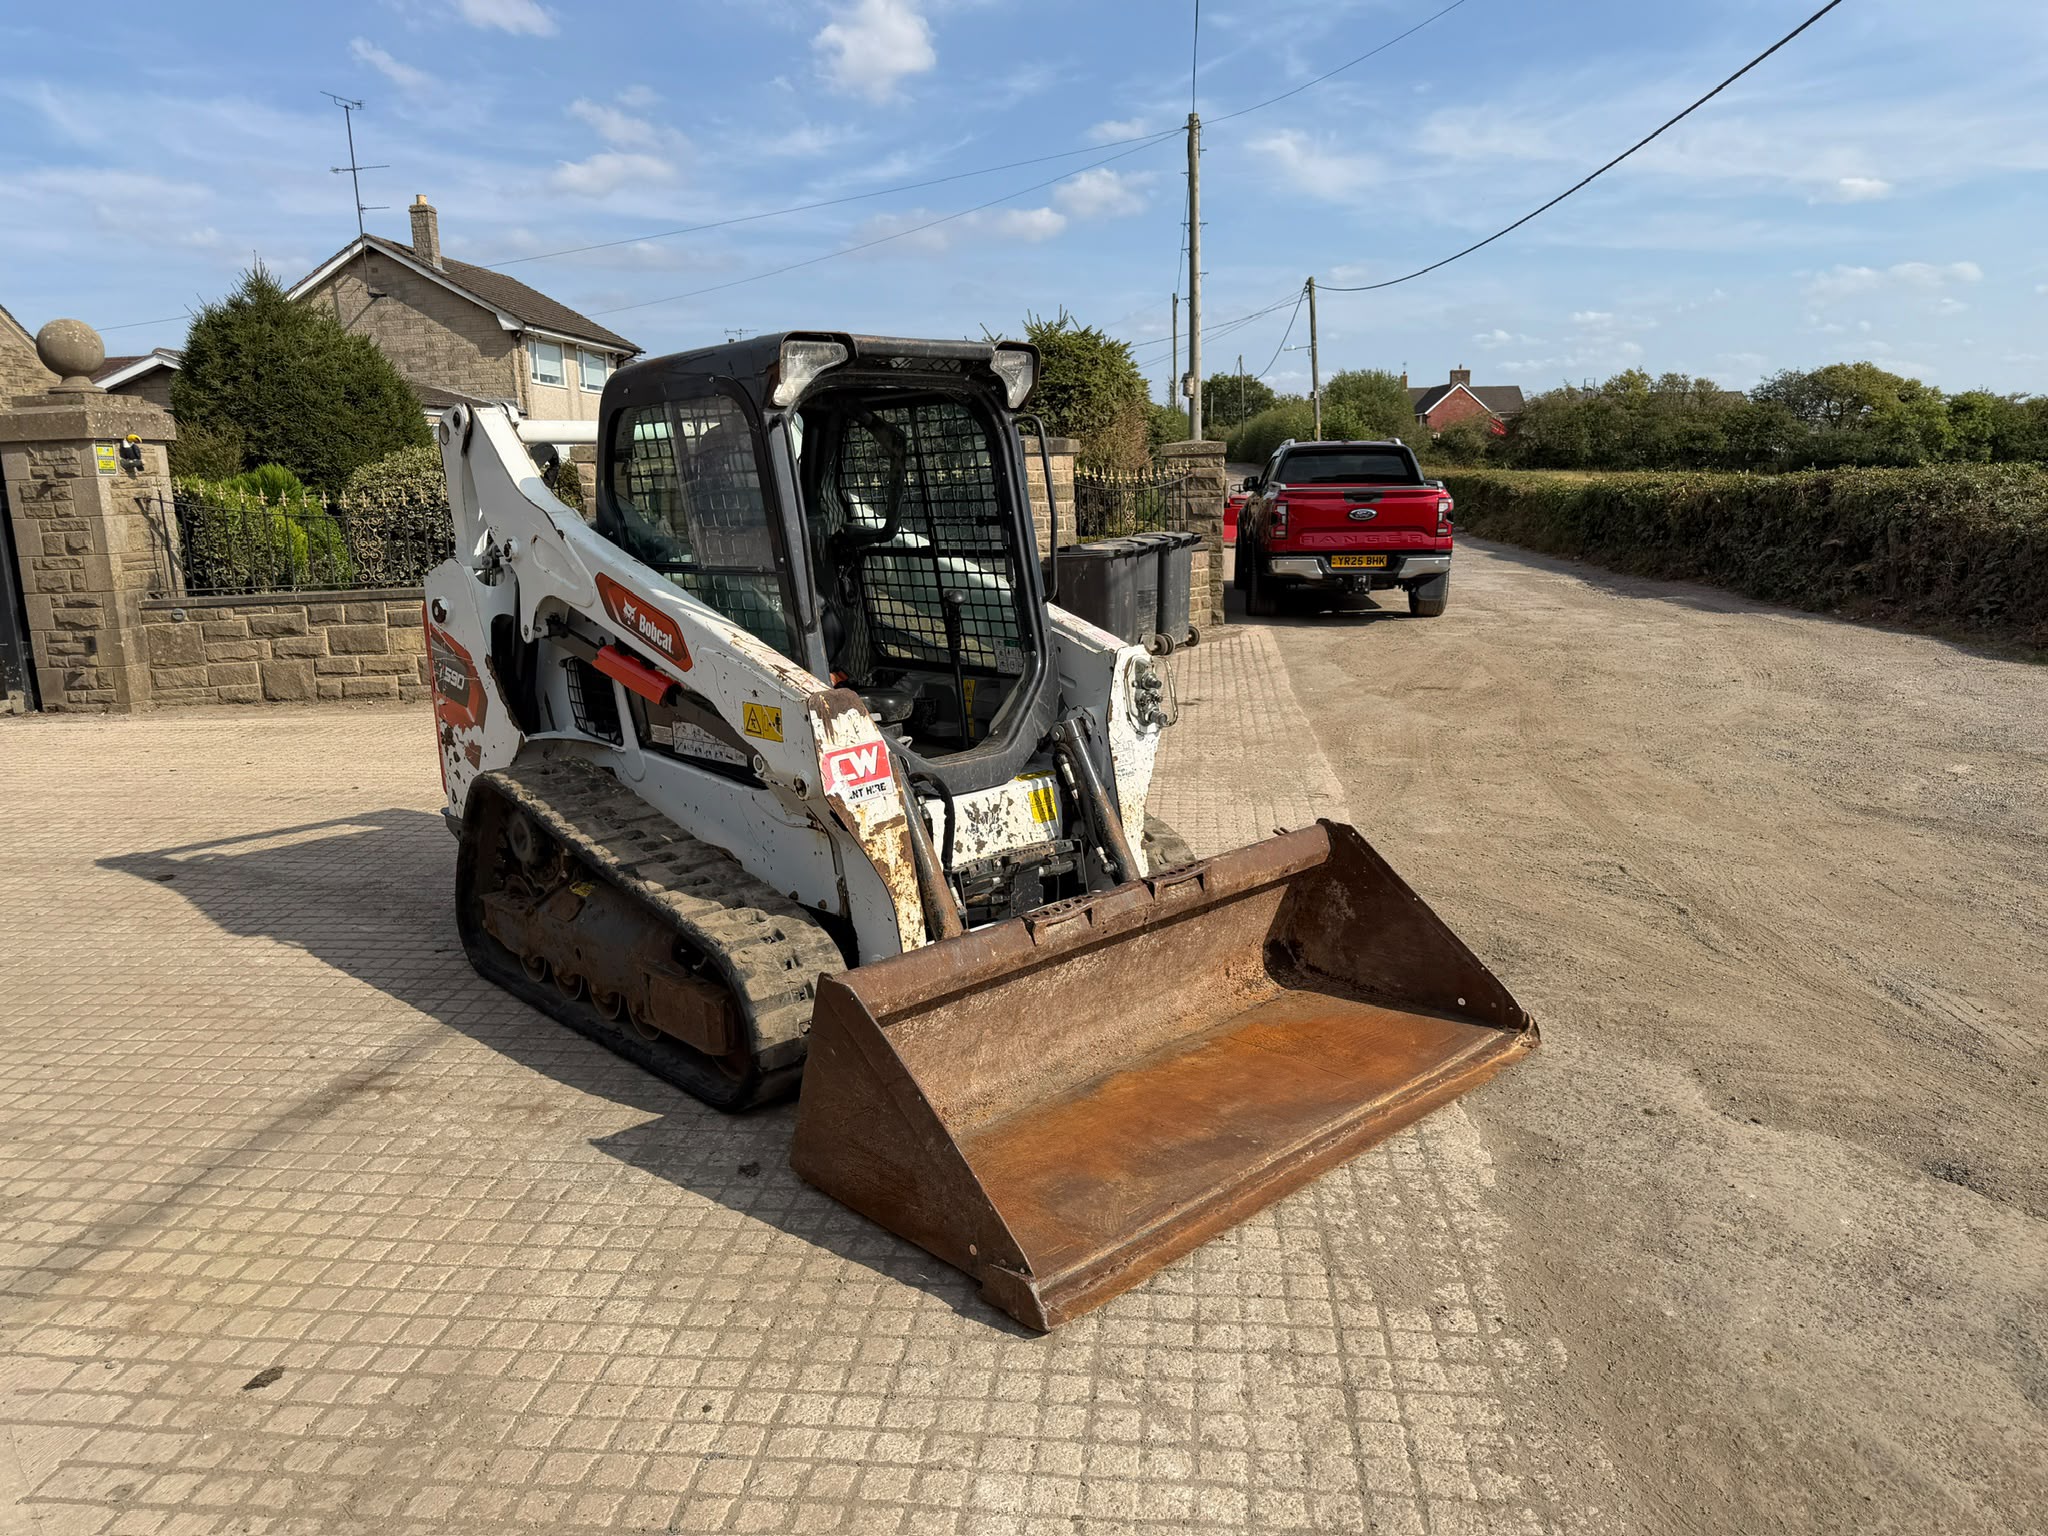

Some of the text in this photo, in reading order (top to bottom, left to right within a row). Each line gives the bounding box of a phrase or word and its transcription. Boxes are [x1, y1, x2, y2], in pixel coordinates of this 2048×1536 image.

[1300, 534, 1424, 544] RANGER
[1338, 556, 1363, 565] YR25
[1366, 556, 1385, 565] BHK
[639, 613, 673, 653] Bobcat
[829, 745, 878, 782] CW
